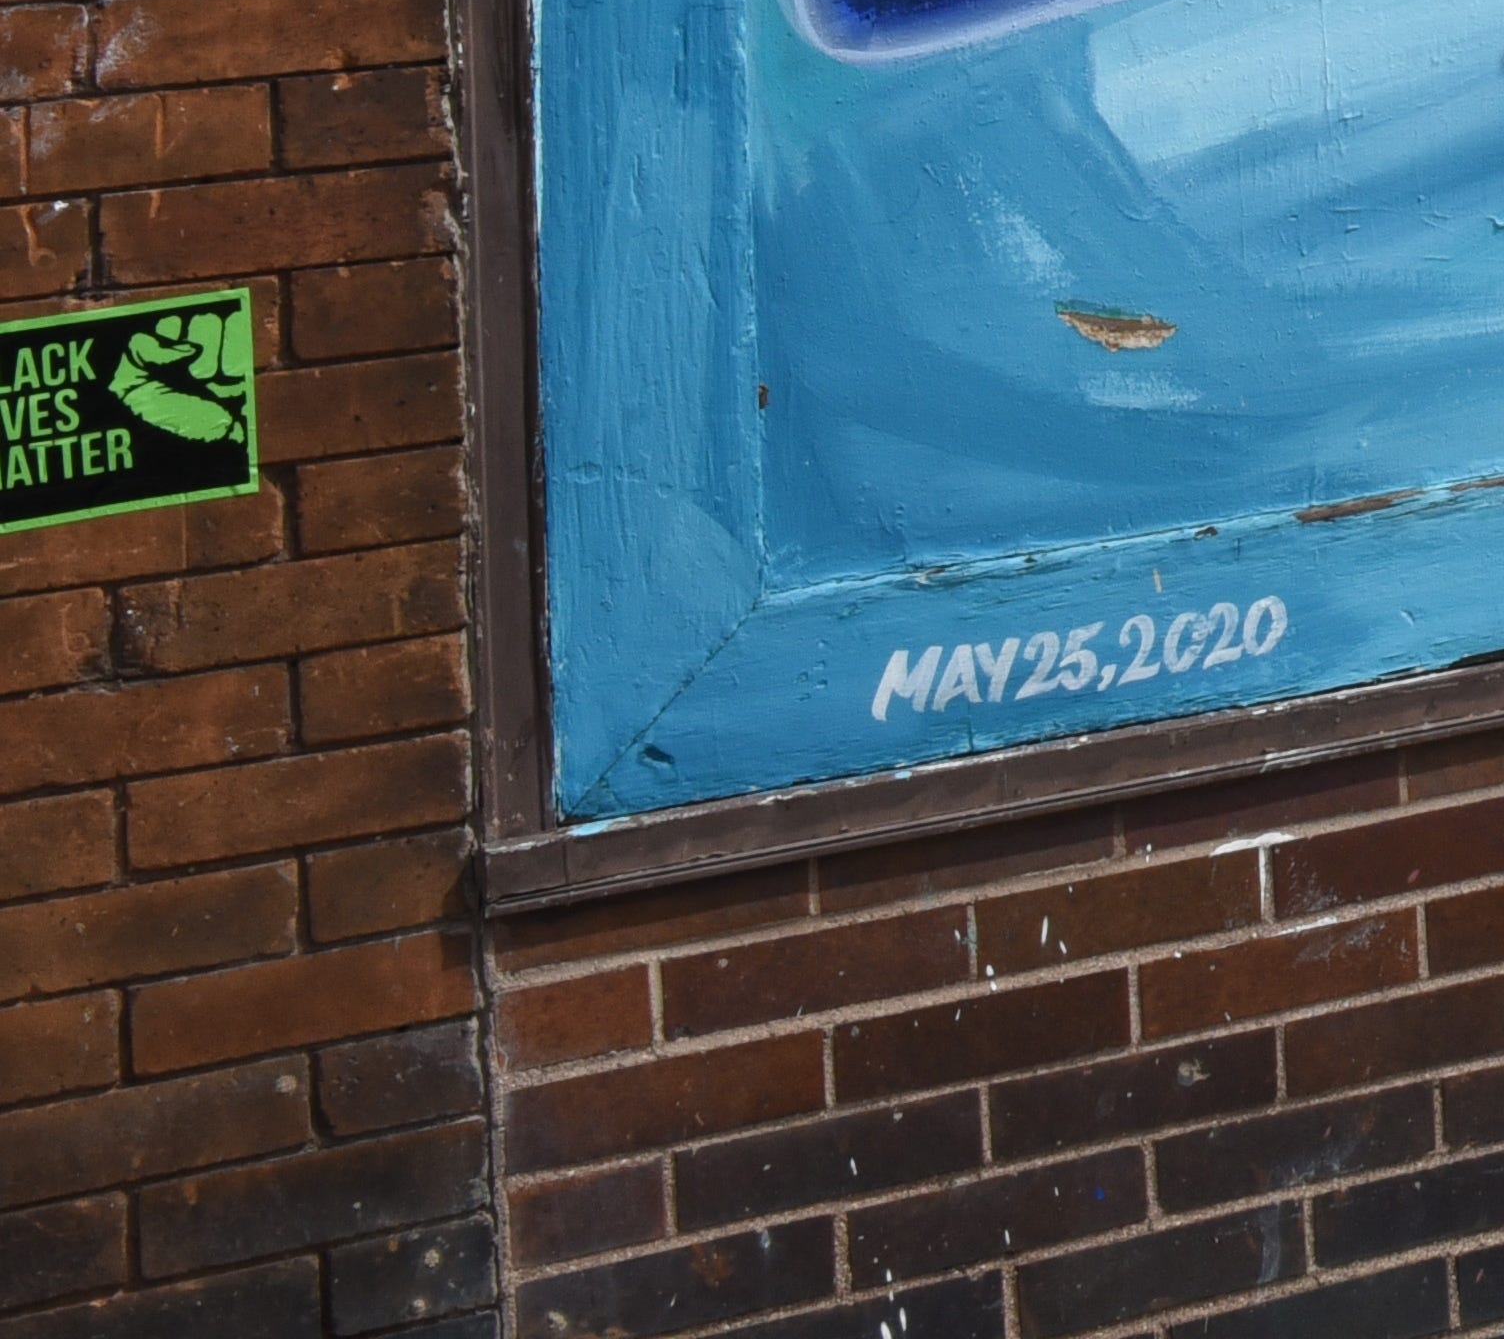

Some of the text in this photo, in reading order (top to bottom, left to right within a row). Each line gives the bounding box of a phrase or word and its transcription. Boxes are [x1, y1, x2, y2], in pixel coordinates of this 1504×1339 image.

[0, 338, 96, 395] ACK
[0, 388, 80, 442] VES
[0, 427, 133, 491] ATTER
